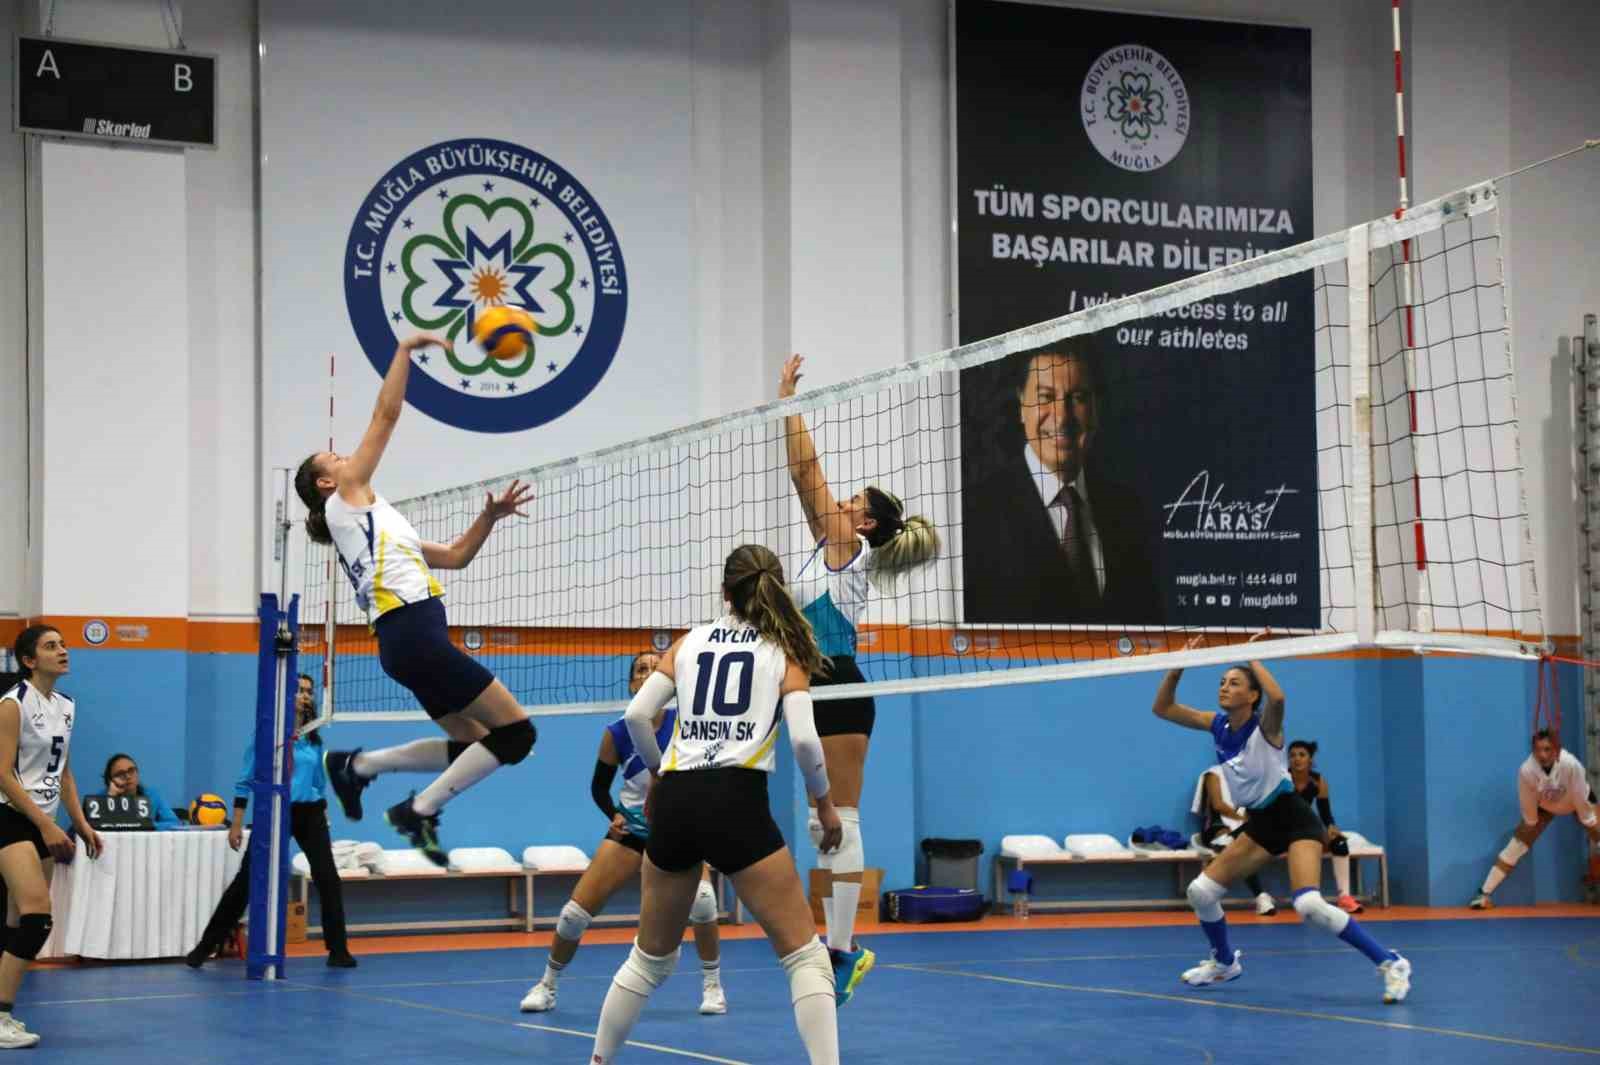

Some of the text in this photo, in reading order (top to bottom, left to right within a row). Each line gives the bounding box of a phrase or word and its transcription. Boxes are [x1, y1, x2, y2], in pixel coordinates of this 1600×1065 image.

[36, 50, 61, 79] A
[174, 63, 193, 92] B
[353, 143, 622, 295] T.C. MUĞLA BÜYÜKŞEHİR BELEDİYESİ
[974, 184, 1295, 234] TÜM SPORCULARIMIZA
[992, 234, 1155, 268] BAŞARILAR
[1233, 302, 1254, 321] to
[1261, 301, 1288, 322] all
[1116, 327, 1249, 350] our athletes
[1204, 513, 1263, 531] ARAS
[1269, 573, 1283, 585] 48
[1285, 573, 1297, 585] 01
[708, 626, 759, 643] AYLİN
[692, 651, 754, 716] 10
[681, 720, 756, 740] CANSIN SK
[47, 736, 64, 773] 5
[89, 797, 149, 818] 2 0 0 5
